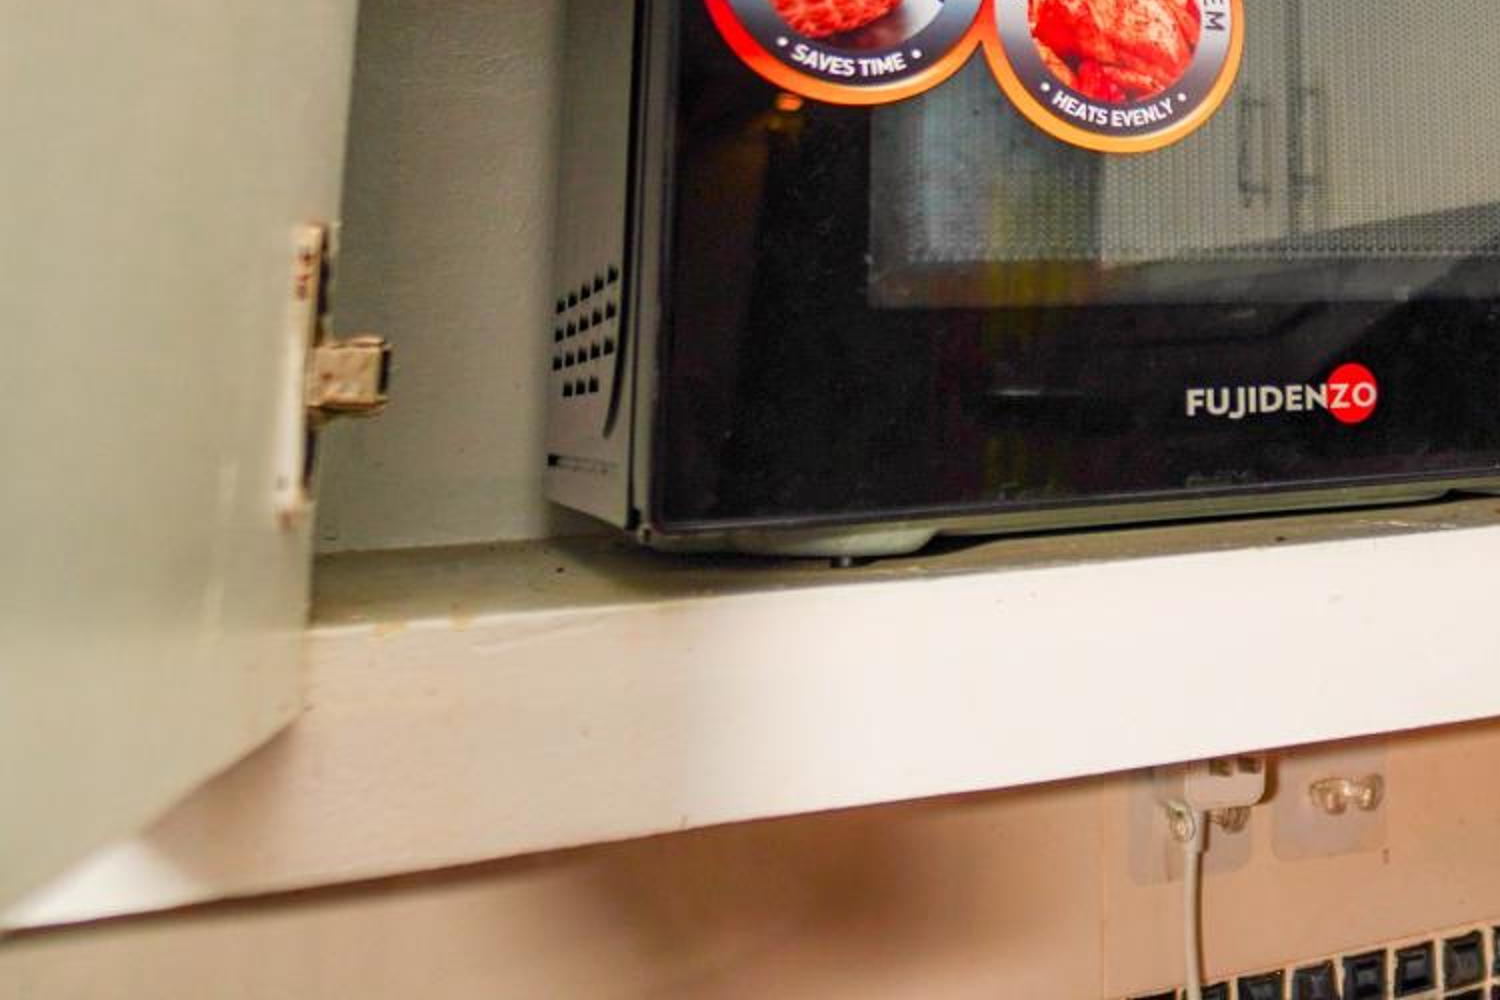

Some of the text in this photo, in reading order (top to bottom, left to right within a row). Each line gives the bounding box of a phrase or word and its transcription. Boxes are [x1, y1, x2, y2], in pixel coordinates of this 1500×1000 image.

[790, 43, 907, 77] SAVES TIME
[1051, 90, 1175, 128] HEATS EVENLY
[1185, 381, 1378, 419] FUJIDENZO
